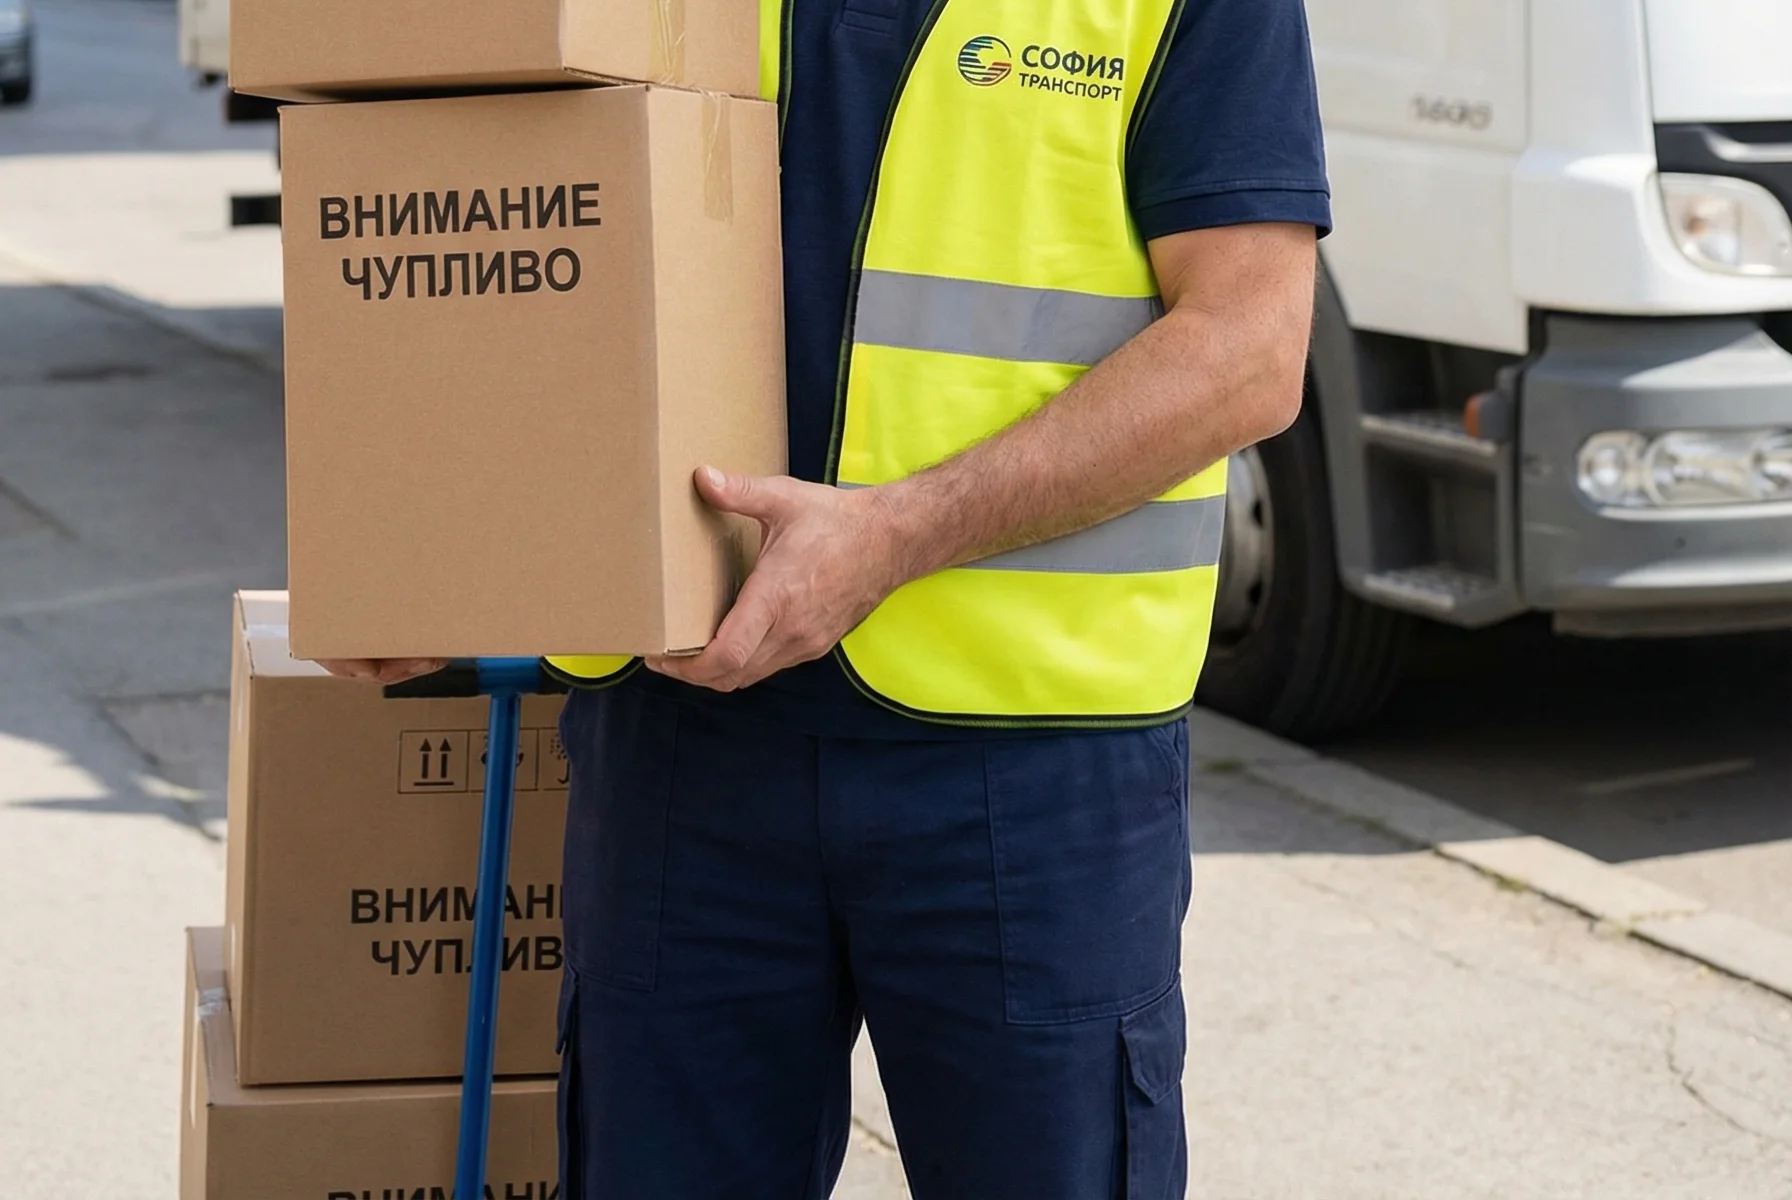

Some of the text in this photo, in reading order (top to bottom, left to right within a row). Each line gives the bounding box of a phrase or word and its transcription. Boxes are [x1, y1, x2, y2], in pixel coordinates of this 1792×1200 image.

[1021, 44, 1125, 81] СОФИЯ
[1018, 72, 1123, 102] ТРАНСПОРТ
[319, 182, 602, 240] ВНИМАНИЕ
[341, 247, 581, 301] ЧУПЛИВО
[350, 883, 564, 924] ВНИМАН
[370, 935, 563, 975] ЧУПИВ
